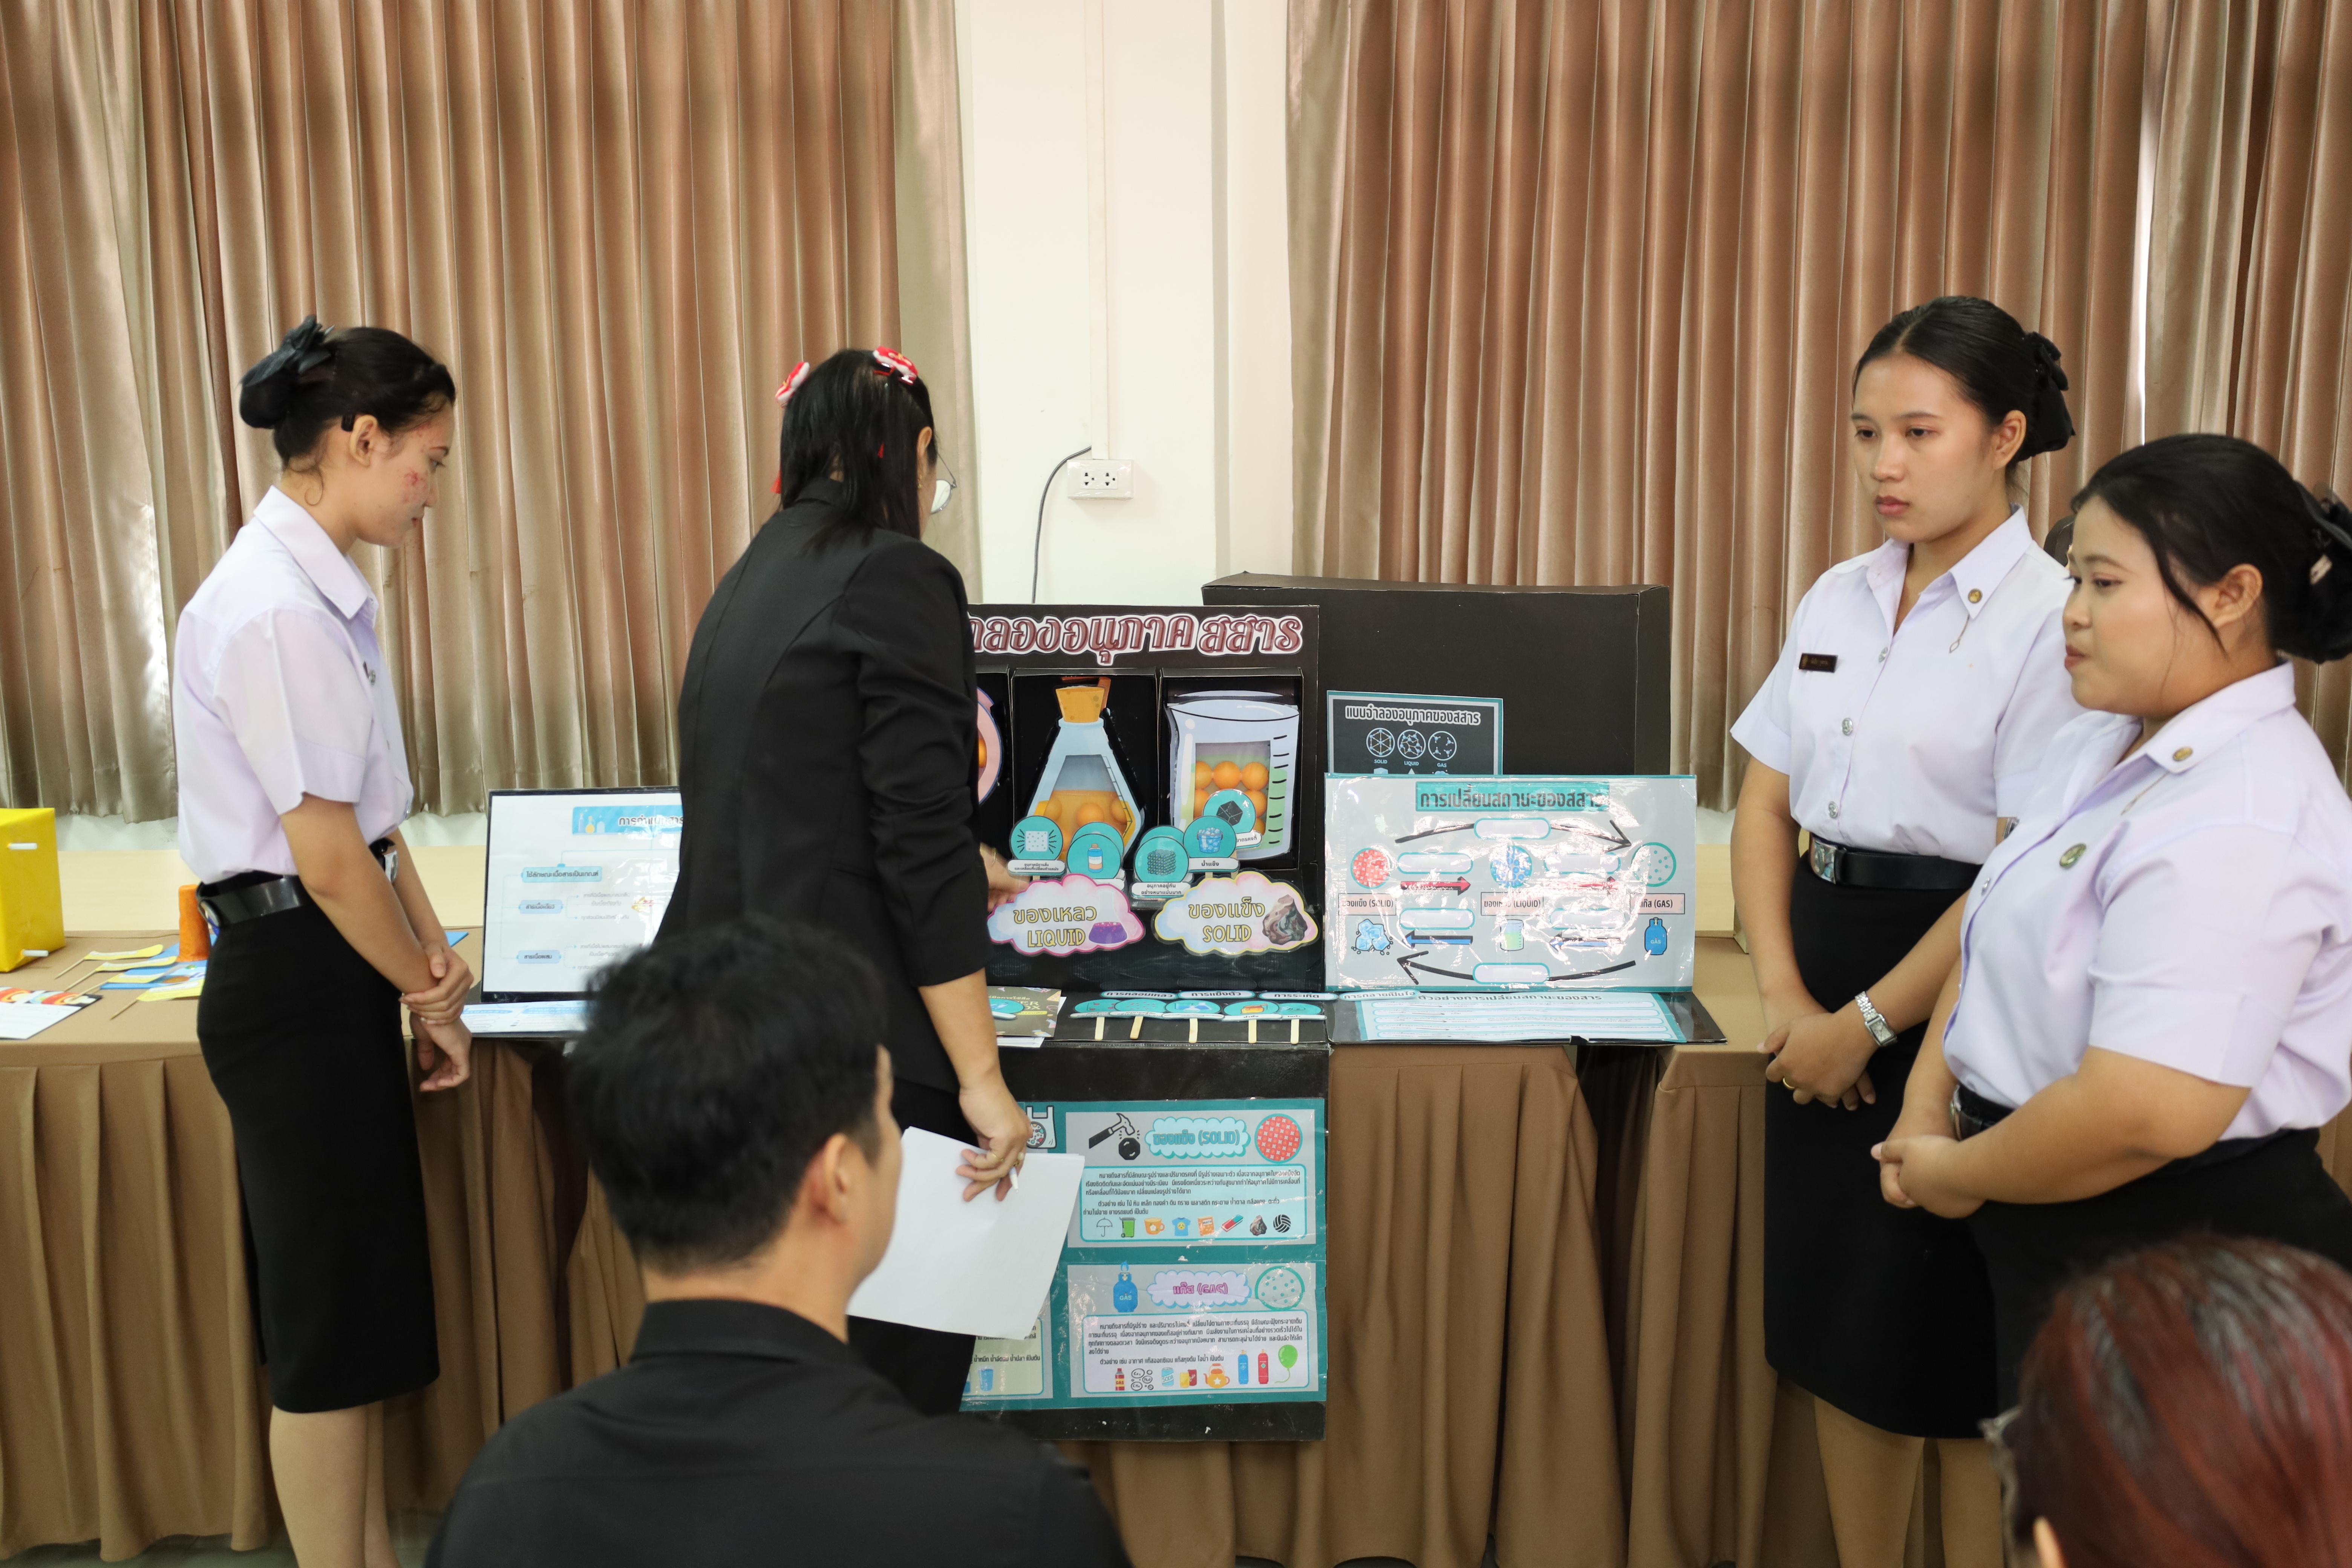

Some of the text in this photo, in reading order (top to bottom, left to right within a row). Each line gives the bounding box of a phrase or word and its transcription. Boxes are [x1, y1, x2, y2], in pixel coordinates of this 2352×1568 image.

[1346, 704, 1480, 725] แบบจำลองอนุภาคของสสาร
[1189, 897, 1265, 918] ของแข็ง
[1513, 900, 1541, 908] (LIQUID)
[1654, 899, 1673, 908] (GAS)
[1014, 906, 1097, 924] ของเหลว
[1028, 928, 1085, 947] LIQUID
[1203, 925, 1251, 942] SOLID
[1153, 1129, 1240, 1146] ของแข็ง (SOLID)
[1199, 1170, 1235, 1179] มีรูปร่างเฉพาะตัว
[1137, 1187, 1191, 1196] เปลี่ยนแปลงรูปร่างได้ยาก
[1173, 1282, 1194, 1294] แก๊ส
[1100, 1321, 1147, 1330] หมายถึงสารที่มีรูปร่าง
[1089, 1330, 1117, 1338] ภาชนะที่บรรจุ
